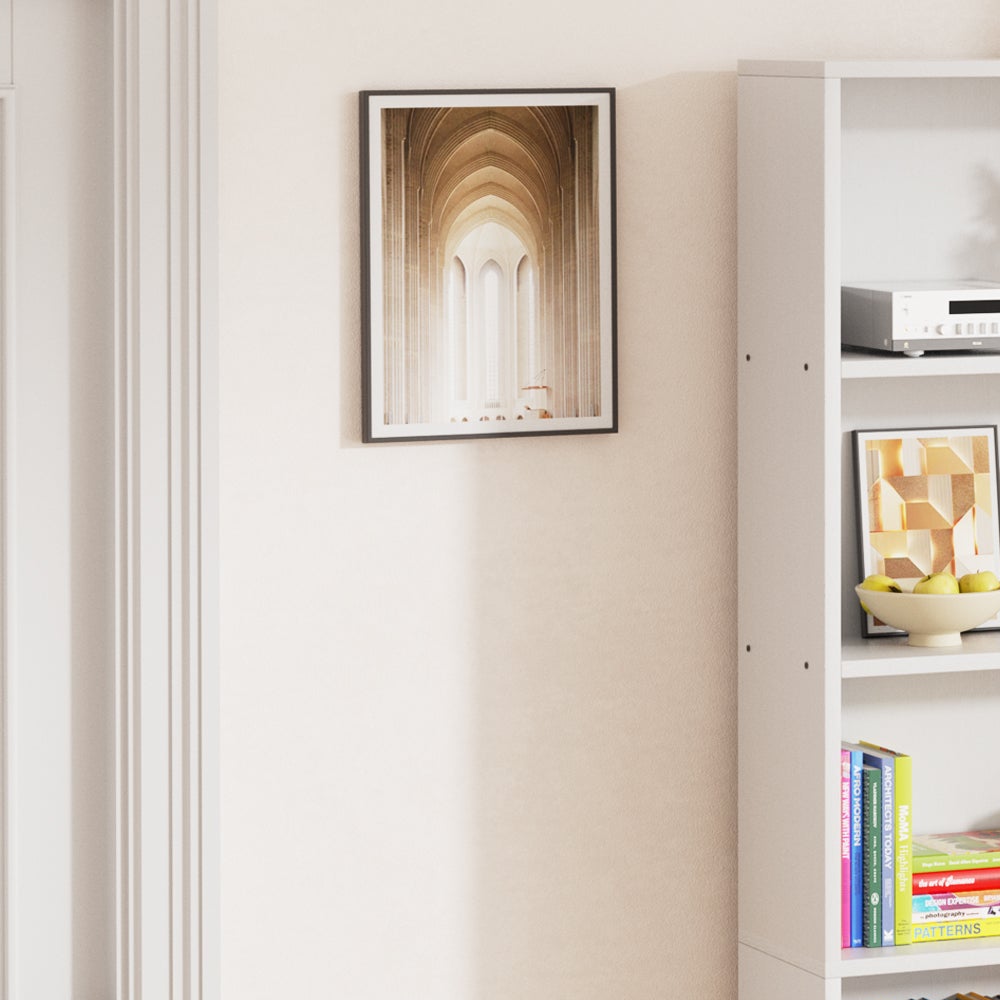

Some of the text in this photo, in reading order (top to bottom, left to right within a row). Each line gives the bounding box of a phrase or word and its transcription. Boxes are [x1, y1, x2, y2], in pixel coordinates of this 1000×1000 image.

[853, 765, 862, 797] AFRO
[884, 765, 892, 831] ARCHITECTS
[853, 798, 862, 847] MODERN
[884, 833, 892, 869] TODAY
[896, 805, 909, 892] MoMA Highlights
[918, 879, 928, 888] the
[929, 879, 938, 887] art
[913, 922, 982, 940] PATTERNS
[925, 911, 965, 920] photography
